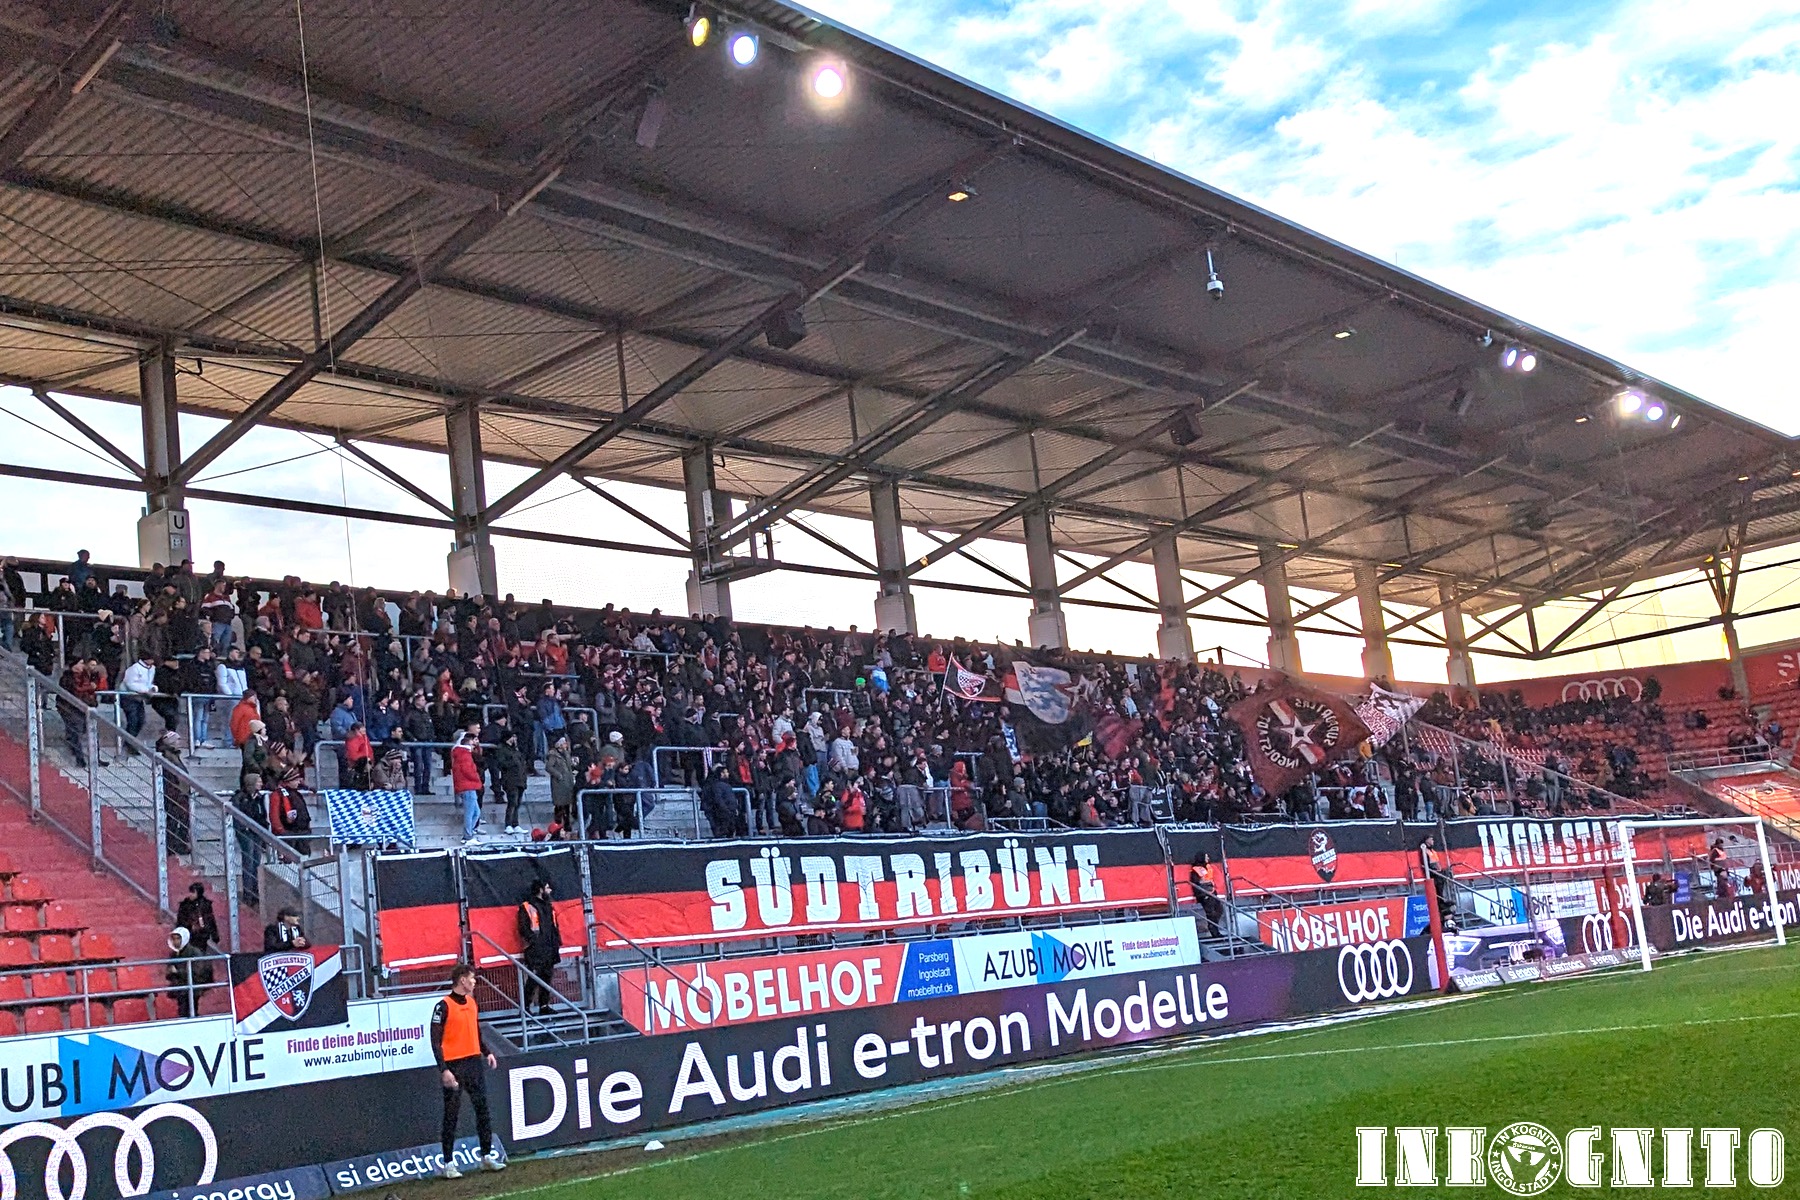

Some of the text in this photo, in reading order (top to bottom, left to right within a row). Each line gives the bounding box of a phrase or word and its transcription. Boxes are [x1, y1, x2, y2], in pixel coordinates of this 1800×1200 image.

[173, 515, 185, 530] U
[705, 838, 1105, 929] SÜDTRIBÜNE
[1271, 906, 1390, 953] MÖBELHOF
[1672, 909, 1704, 942] Die
[1708, 901, 1747, 937] Audi
[918, 952, 949, 963] Parsberg
[918, 967, 951, 981] Ingolstadt
[983, 940, 1116, 982] AZUBI MOVIE
[270, 967, 310, 1000] SCHANZER
[644, 957, 883, 1031] MÖBELHOF
[907, 983, 953, 998] moebelhof.de
[287, 1024, 425, 1054] Finde deine Ausbildung!
[108, 1037, 266, 1101] MOVIE
[303, 1044, 414, 1068] www.azubimovie.de
[511, 978, 1230, 1141] Die Audi e-tron Modelle
[336, 1163, 362, 1188] si
